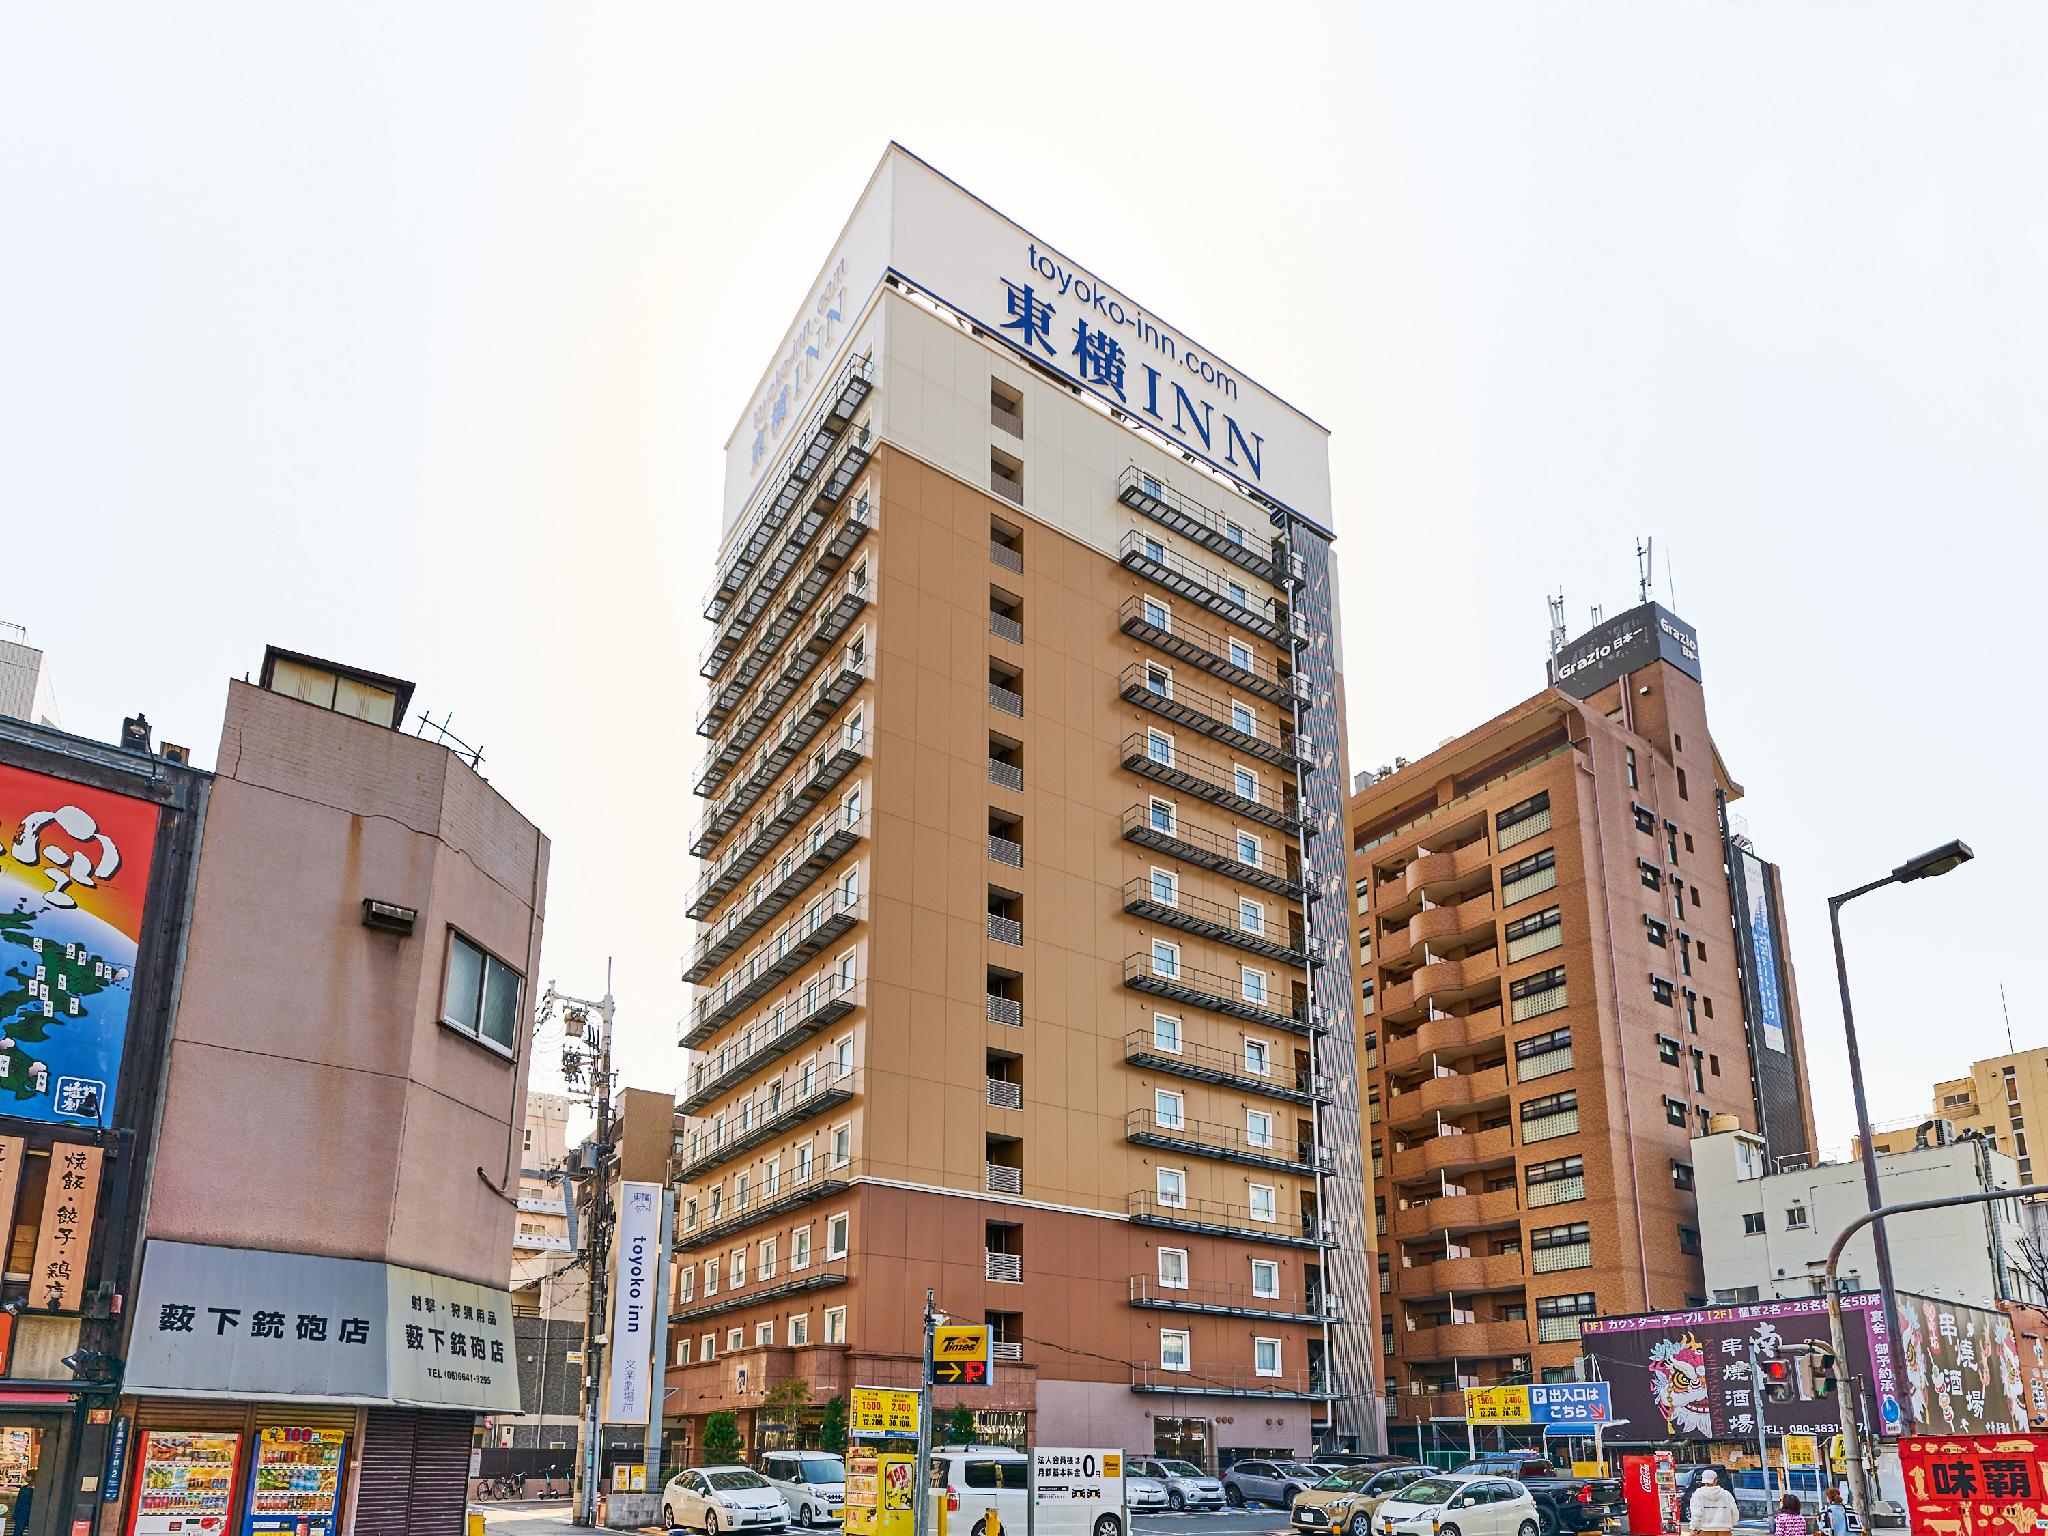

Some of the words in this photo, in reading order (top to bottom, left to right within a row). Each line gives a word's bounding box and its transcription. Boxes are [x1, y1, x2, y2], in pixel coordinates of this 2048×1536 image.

[1028, 243, 1238, 400] toyoko-inn.com
[1000, 276, 1265, 482] 東横INN
[1660, 617, 1697, 651] Grazio
[1558, 645, 1611, 680] Grazio
[628, 1236, 647, 1299] toyoko
[627, 1305, 643, 1333] inn
[942, 1336, 980, 1352] Times
[427, 1368, 443, 1379] TEL
[966, 1361, 984, 1383] P
[1534, 1390, 1545, 1403] P
[1549, 1387, 1599, 1403] 出入口は
[1551, 1404, 1588, 1418] こちら
[1932, 1460, 2031, 1498] 味覇
